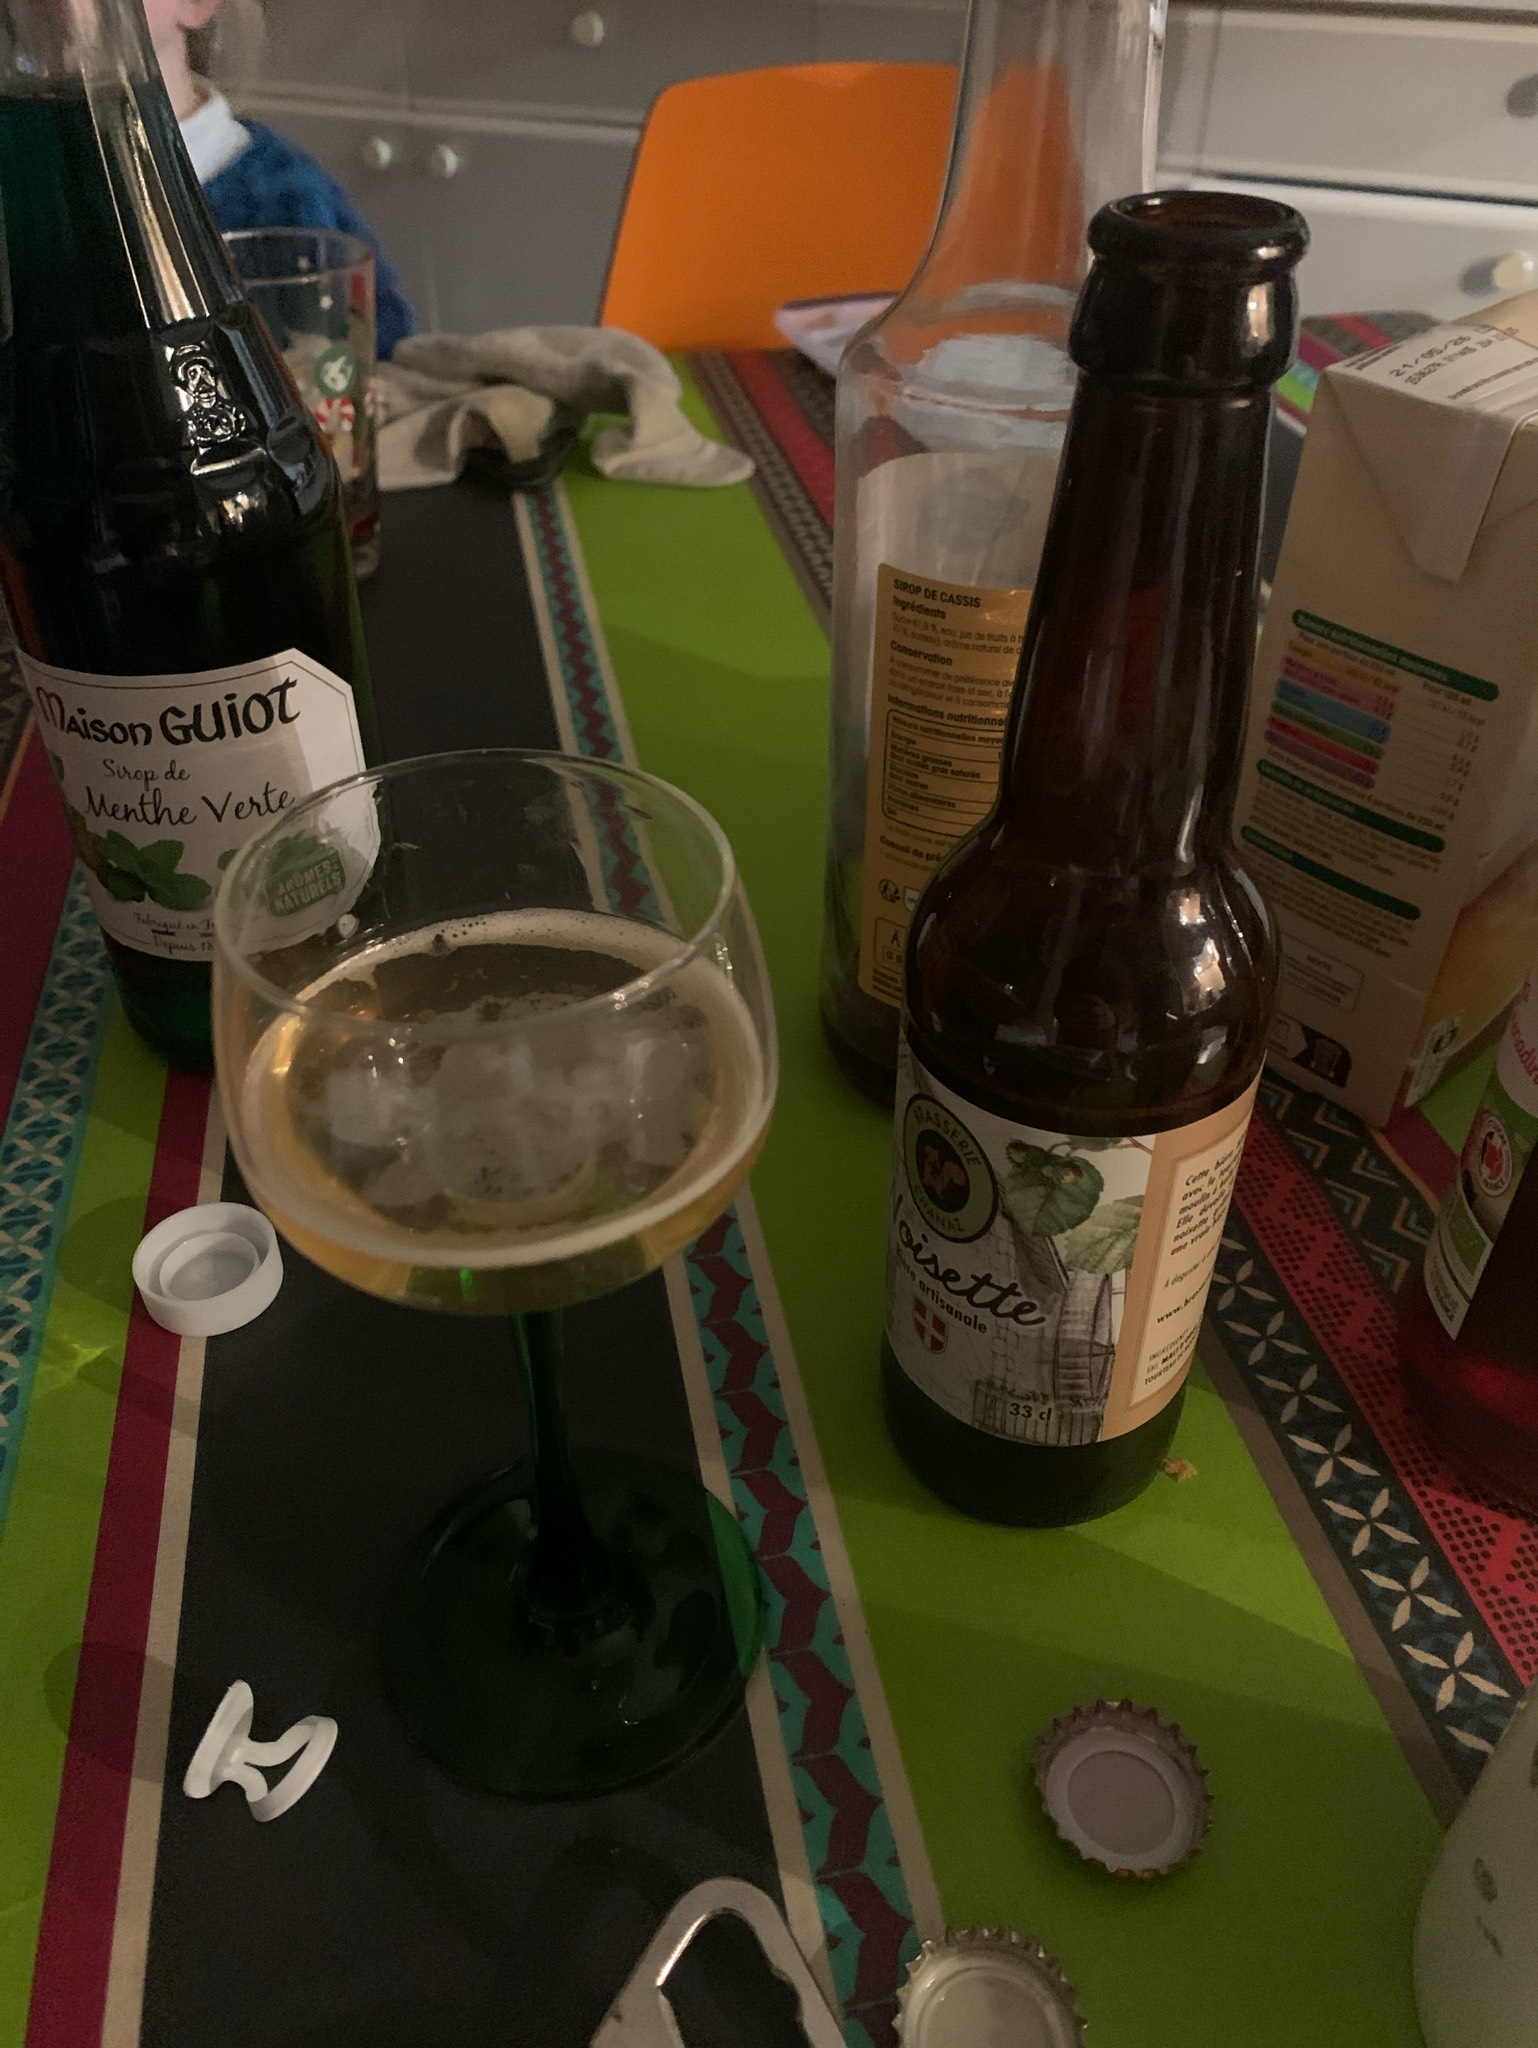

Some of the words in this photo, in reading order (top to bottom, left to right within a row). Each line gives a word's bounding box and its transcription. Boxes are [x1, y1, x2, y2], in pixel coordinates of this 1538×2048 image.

[894, 578, 922, 596] SIROP
[924, 588, 938, 601] DE
[940, 591, 981, 608] CASSIS
[893, 595, 946, 619] Ingrédients
[959, 630, 973, 640] jus
[974, 631, 985, 641] de
[987, 631, 1008, 643] fruits
[971, 641, 1001, 654] naturel
[1003, 645, 1014, 655] de
[890, 640, 953, 666] Conservation
[954, 672, 1000, 687] préférence
[887, 694, 945, 720] Informations
[103, 757, 158, 791] Sirop
[164, 759, 190, 781] de
[85, 786, 197, 826] Menthe
[201, 781, 295, 823] Verte
[273, 871, 341, 913] NATURELS
[153, 935, 196, 954] Depuis
[913, 1105, 981, 1166] BRASSERIE
[1185, 1168, 1210, 1186] Cette
[1178, 1191, 1211, 1215] moulin
[1181, 1186, 1203, 1202] avec
[1173, 1216, 1209, 1243] noisette
[1176, 1214, 1194, 1229] Elle
[1170, 1241, 1188, 1256] une
[919, 1279, 988, 1334] artisanale
[1009, 1401, 1033, 1420] 33
[1038, 1406, 1053, 1422] cl
